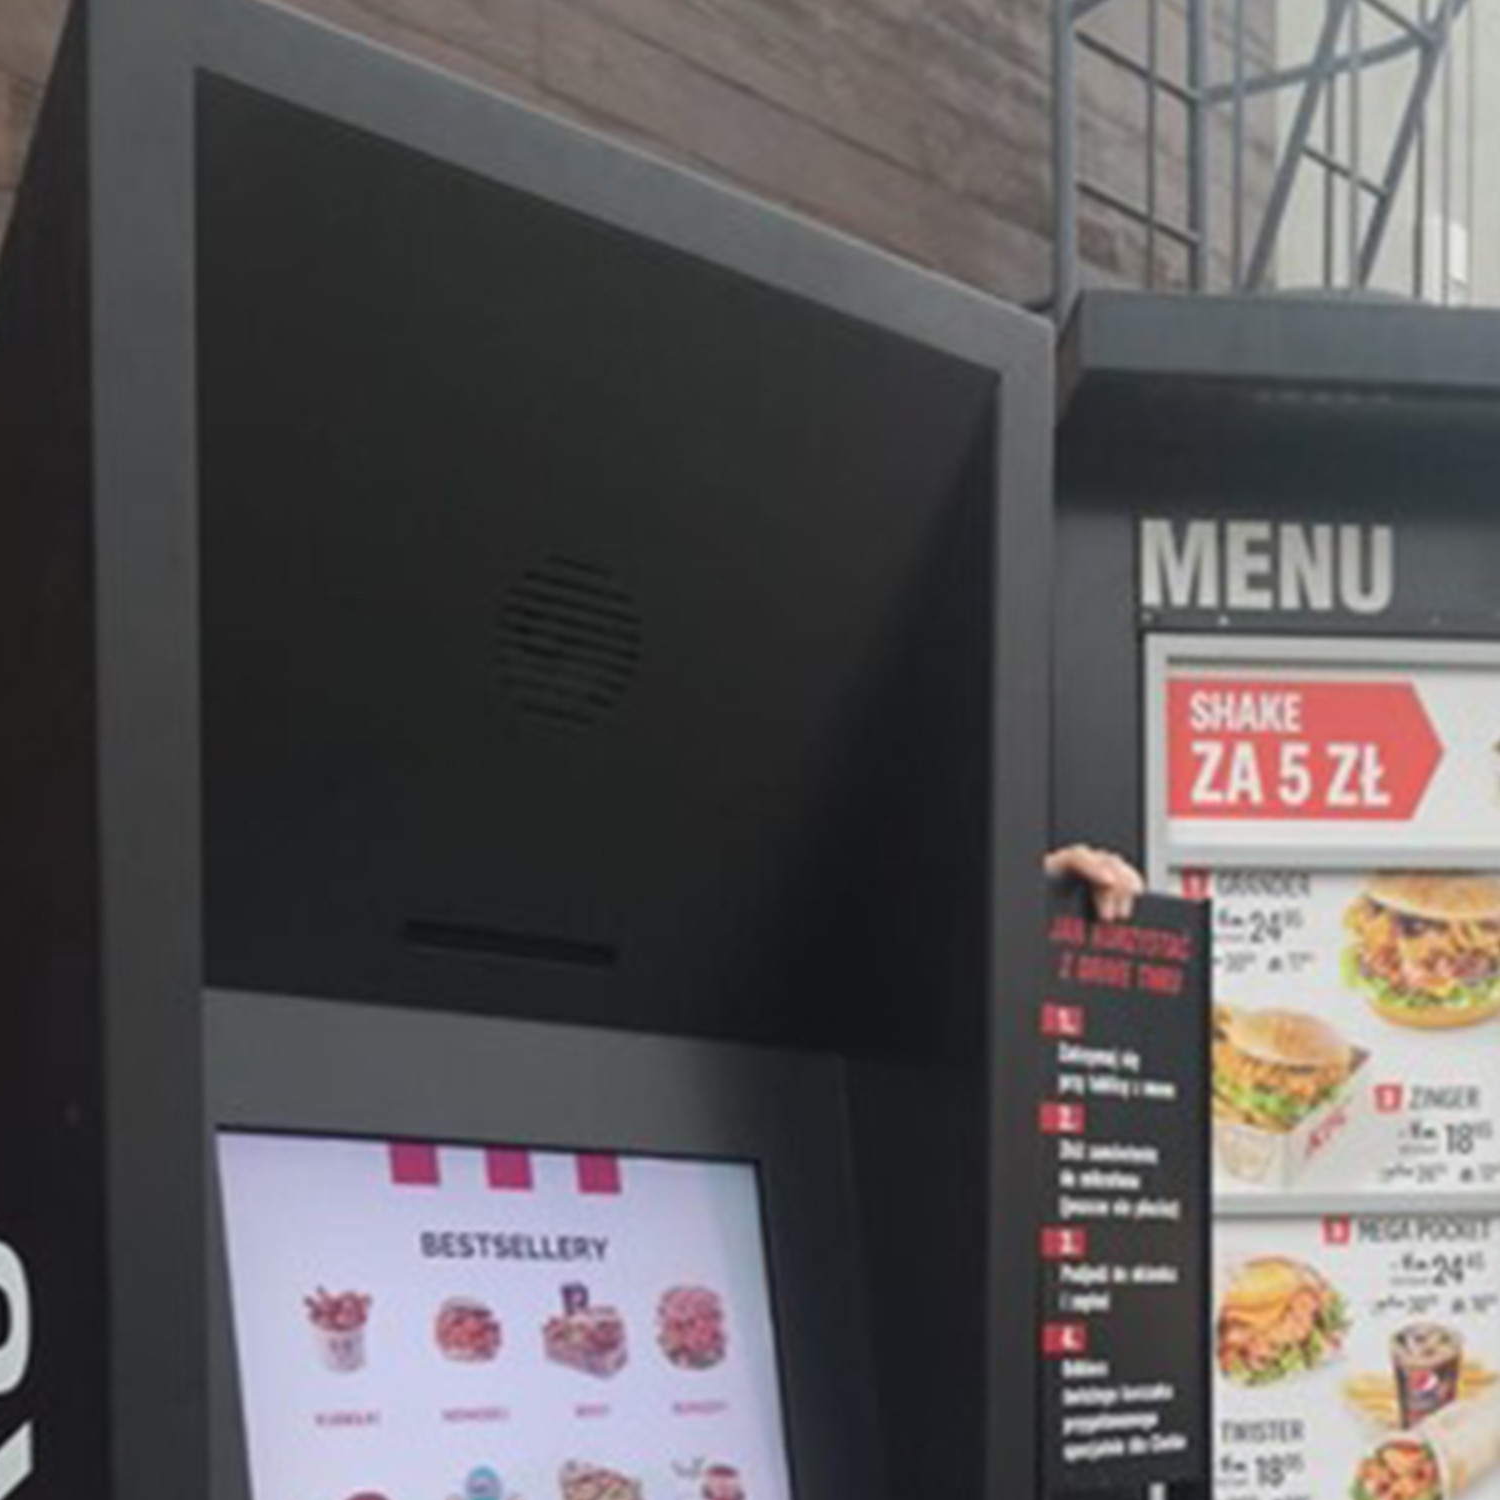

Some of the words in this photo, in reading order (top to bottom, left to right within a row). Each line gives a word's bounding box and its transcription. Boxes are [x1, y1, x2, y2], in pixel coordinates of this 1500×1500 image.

[1140, 518, 1393, 614] MENU
[1188, 691, 1303, 733] SHAKE
[1190, 740, 1263, 805] ZA
[1278, 742, 1312, 805] 5
[1325, 742, 1392, 806] ZŁ
[1407, 1085, 1480, 1111] ZINGER
[420, 1231, 610, 1263] BESTSELLERY
[1219, 1419, 1305, 1444] TWISTER
